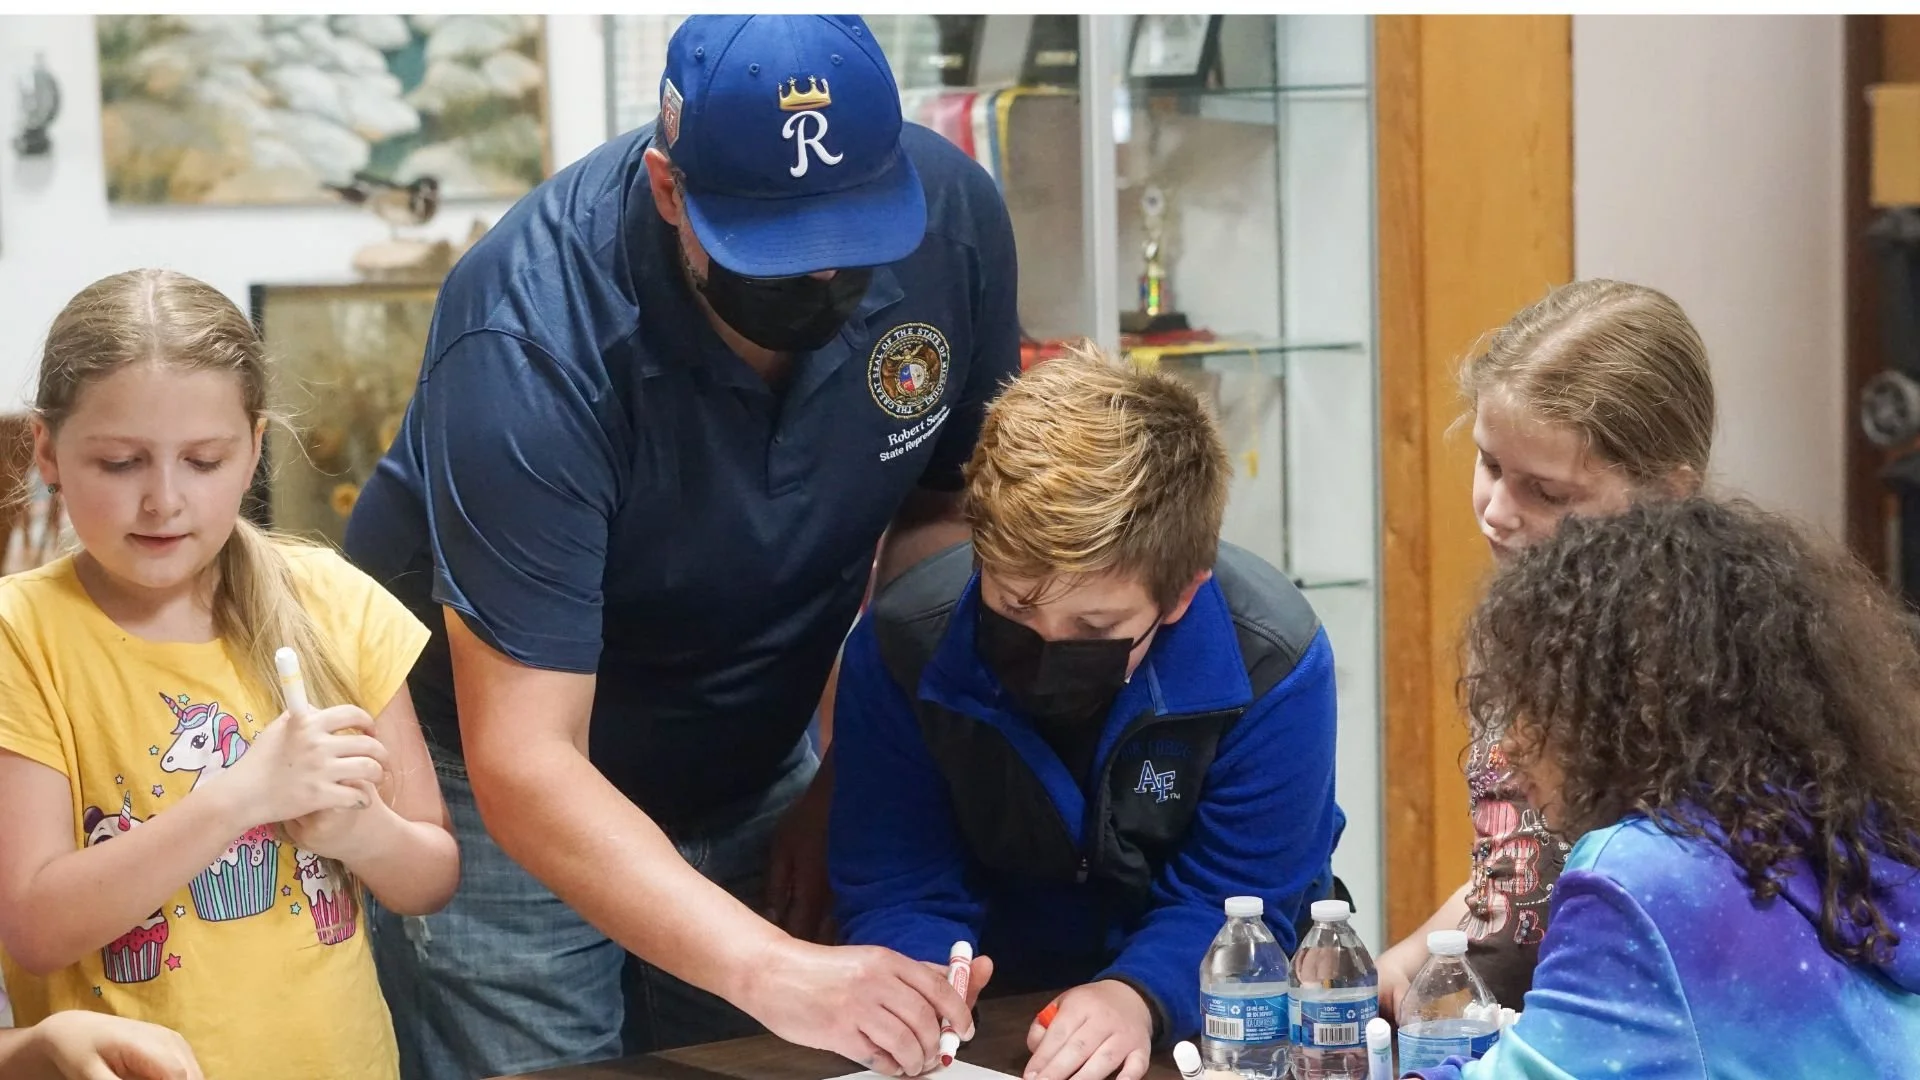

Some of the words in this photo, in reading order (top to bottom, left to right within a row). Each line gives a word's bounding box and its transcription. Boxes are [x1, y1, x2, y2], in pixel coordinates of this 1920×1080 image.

[782, 110, 844, 178] R
[894, 328, 913, 340] THE
[917, 327, 941, 345] STATE
[881, 337, 892, 350] OF
[940, 345, 947, 358] OF
[873, 353, 883, 378] SEAL
[874, 382, 894, 409] GREAT
[896, 405, 913, 414] THE
[888, 421, 924, 446] Robert
[880, 447, 904, 462] State
[1133, 759, 1176, 804] AF
